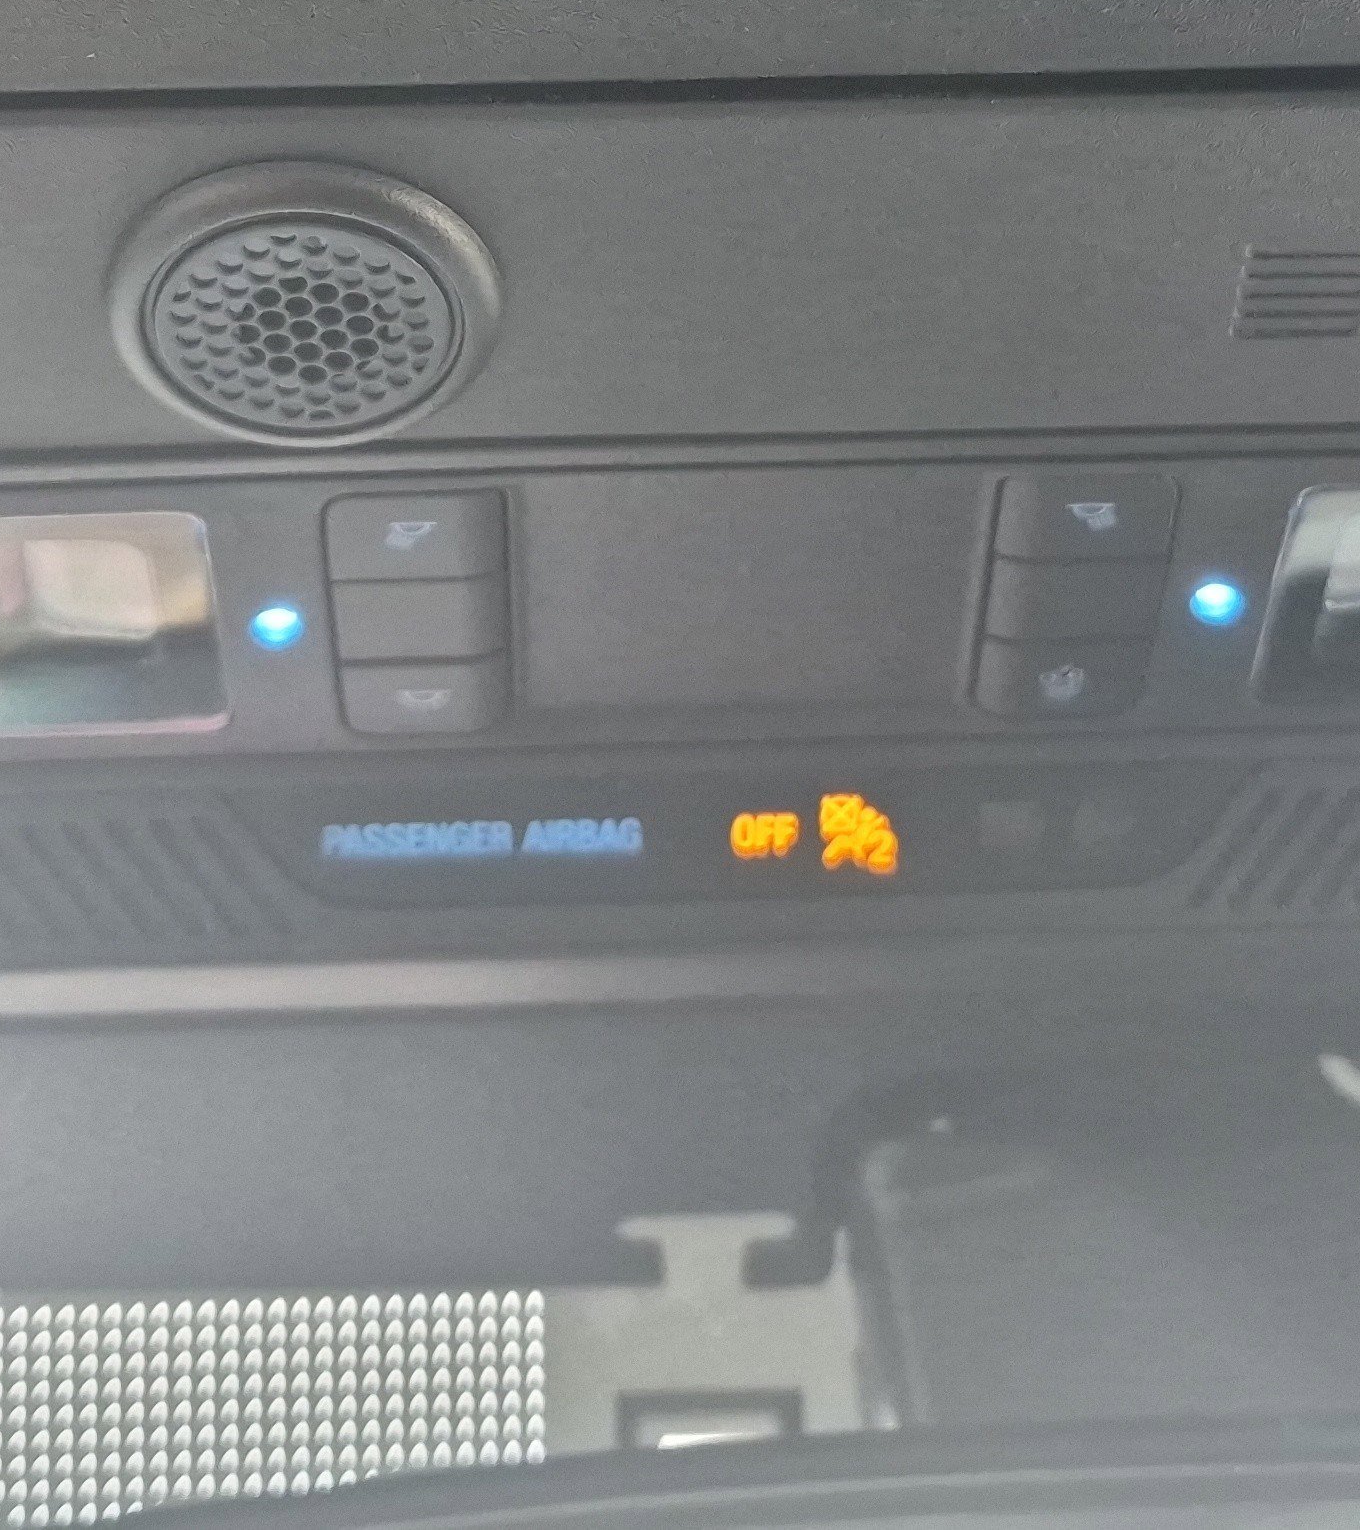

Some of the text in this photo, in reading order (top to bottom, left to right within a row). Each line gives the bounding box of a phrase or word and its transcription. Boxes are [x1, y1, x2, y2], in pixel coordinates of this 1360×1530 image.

[320, 812, 800, 859] PASSENGER AIRBAG OFF
